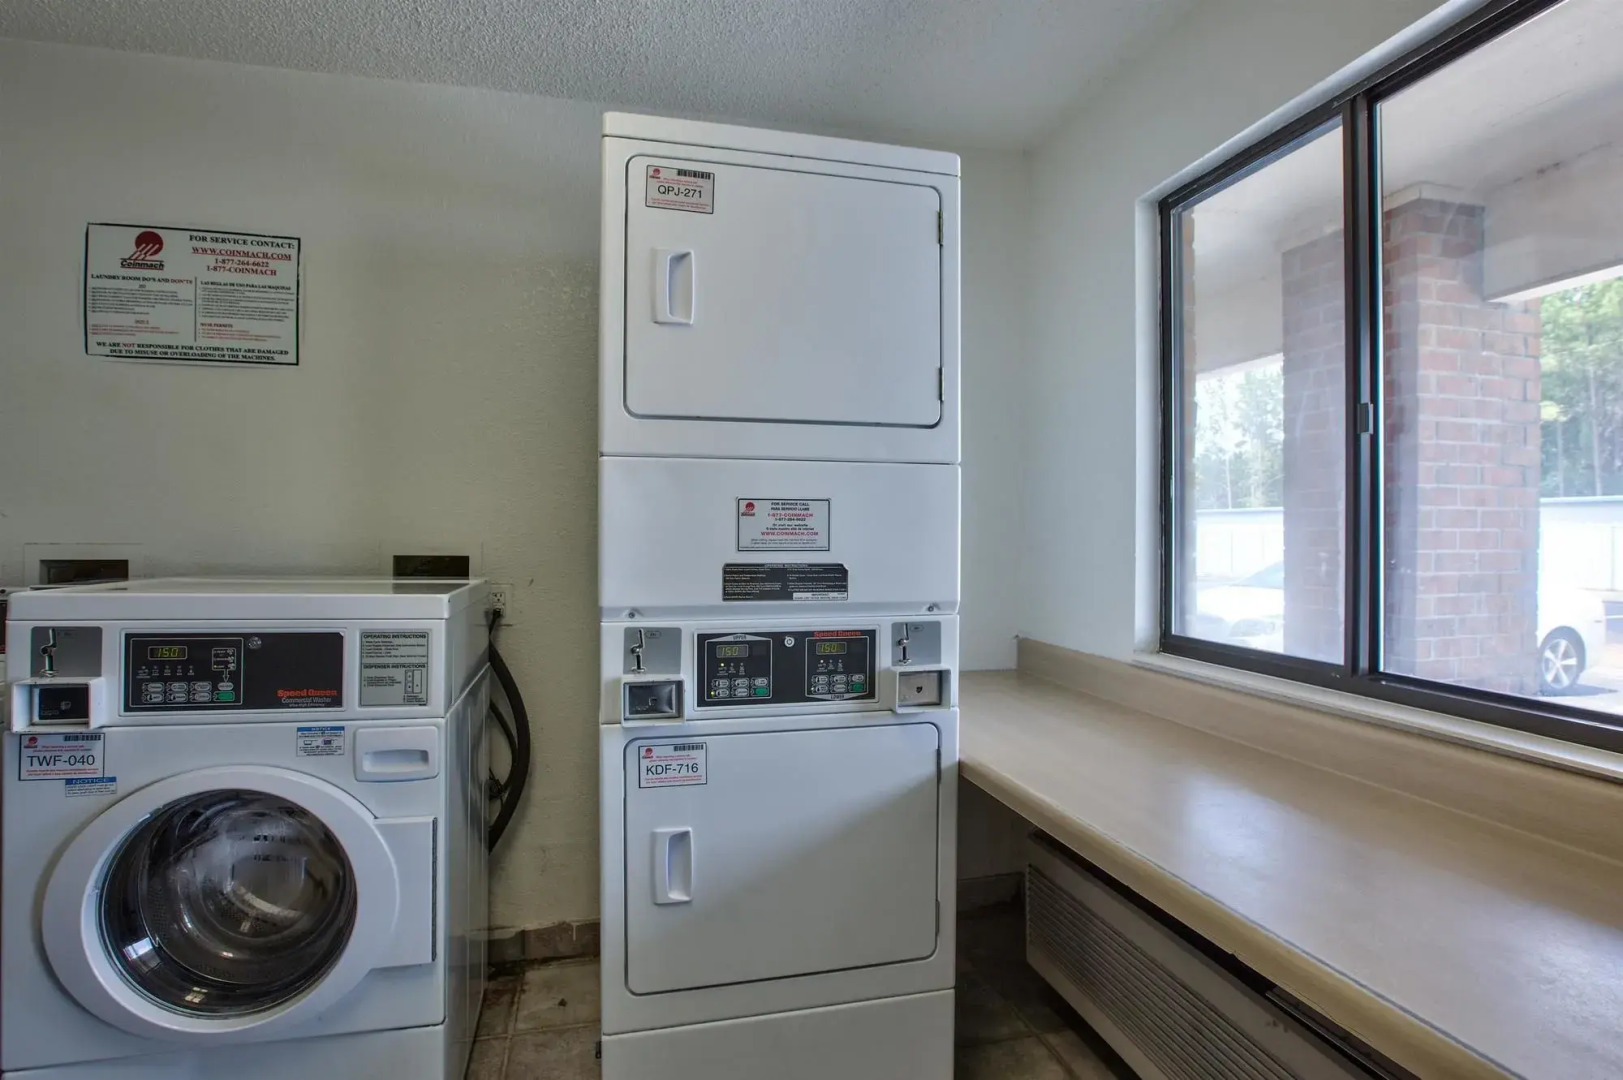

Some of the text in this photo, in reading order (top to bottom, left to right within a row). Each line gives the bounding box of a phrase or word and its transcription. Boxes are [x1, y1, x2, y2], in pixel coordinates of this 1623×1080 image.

[658, 184, 702, 198] QPJ-271
[189, 234, 295, 249] FOR SERVICE CONTACT:
[192, 246, 292, 260] WWW.COINMACH.COM
[120, 260, 164, 269] Coinmach
[215, 258, 269, 267] 1-877-264-6622
[207, 265, 277, 276] 1-877-COINMACH
[158, 647, 178, 657] 150
[722, 647, 739, 656] 150
[821, 643, 837, 652] 150
[277, 689, 307, 697] Speed
[27, 754, 95, 767] TWF-040
[646, 763, 699, 776] KDF-716
